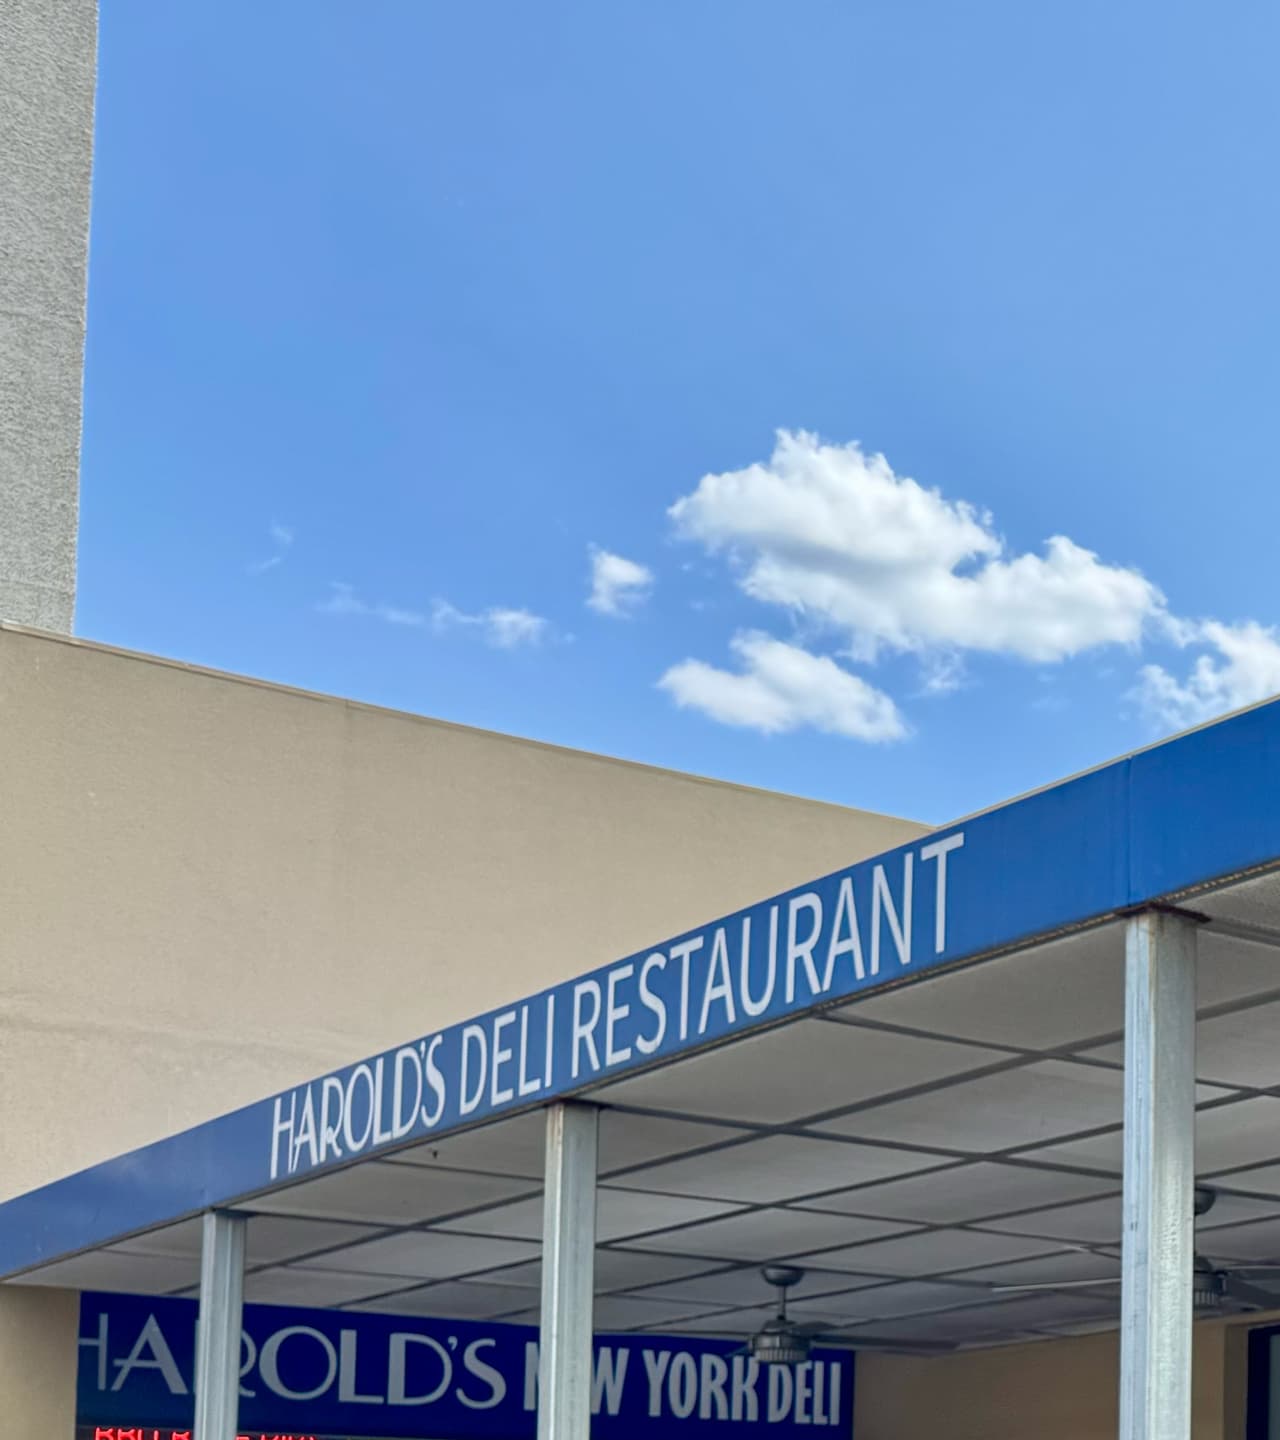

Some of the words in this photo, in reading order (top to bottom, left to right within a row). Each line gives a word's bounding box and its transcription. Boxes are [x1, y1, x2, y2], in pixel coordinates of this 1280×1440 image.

[269, 1031, 446, 1181] HAROLD'S
[458, 993, 555, 1115] DELI
[570, 832, 965, 1079] RESTAURANT
[522, 1340, 630, 1416] NW
[642, 1348, 760, 1423] YORK
[767, 1359, 842, 1426] DELI
